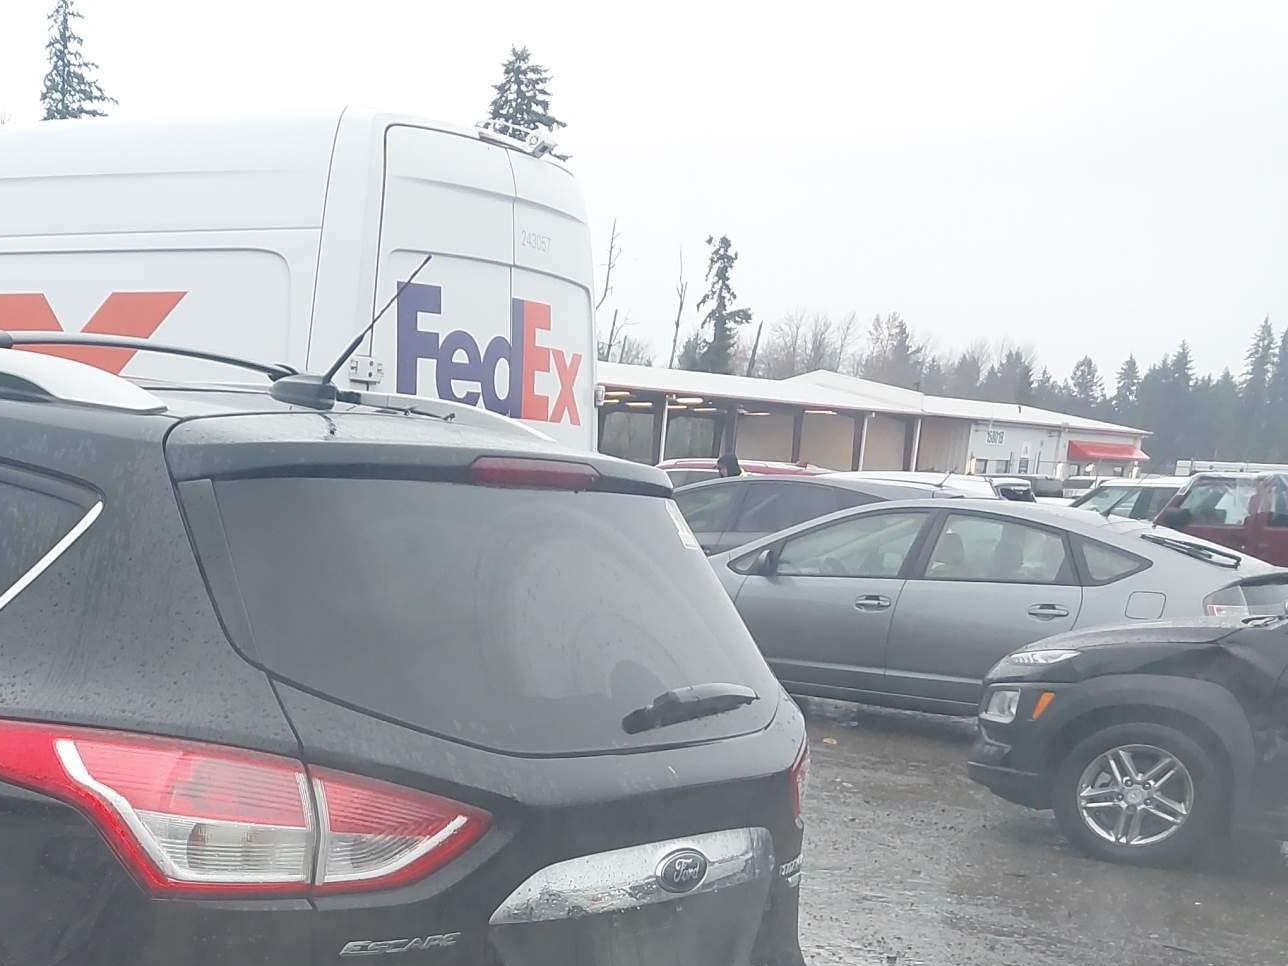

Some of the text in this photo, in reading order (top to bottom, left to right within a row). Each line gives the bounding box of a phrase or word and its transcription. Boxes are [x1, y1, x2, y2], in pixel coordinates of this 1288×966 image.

[396, 280, 582, 427] FedEx
[673, 858, 700, 882] Ford
[339, 932, 461, 956] ESCAPE
